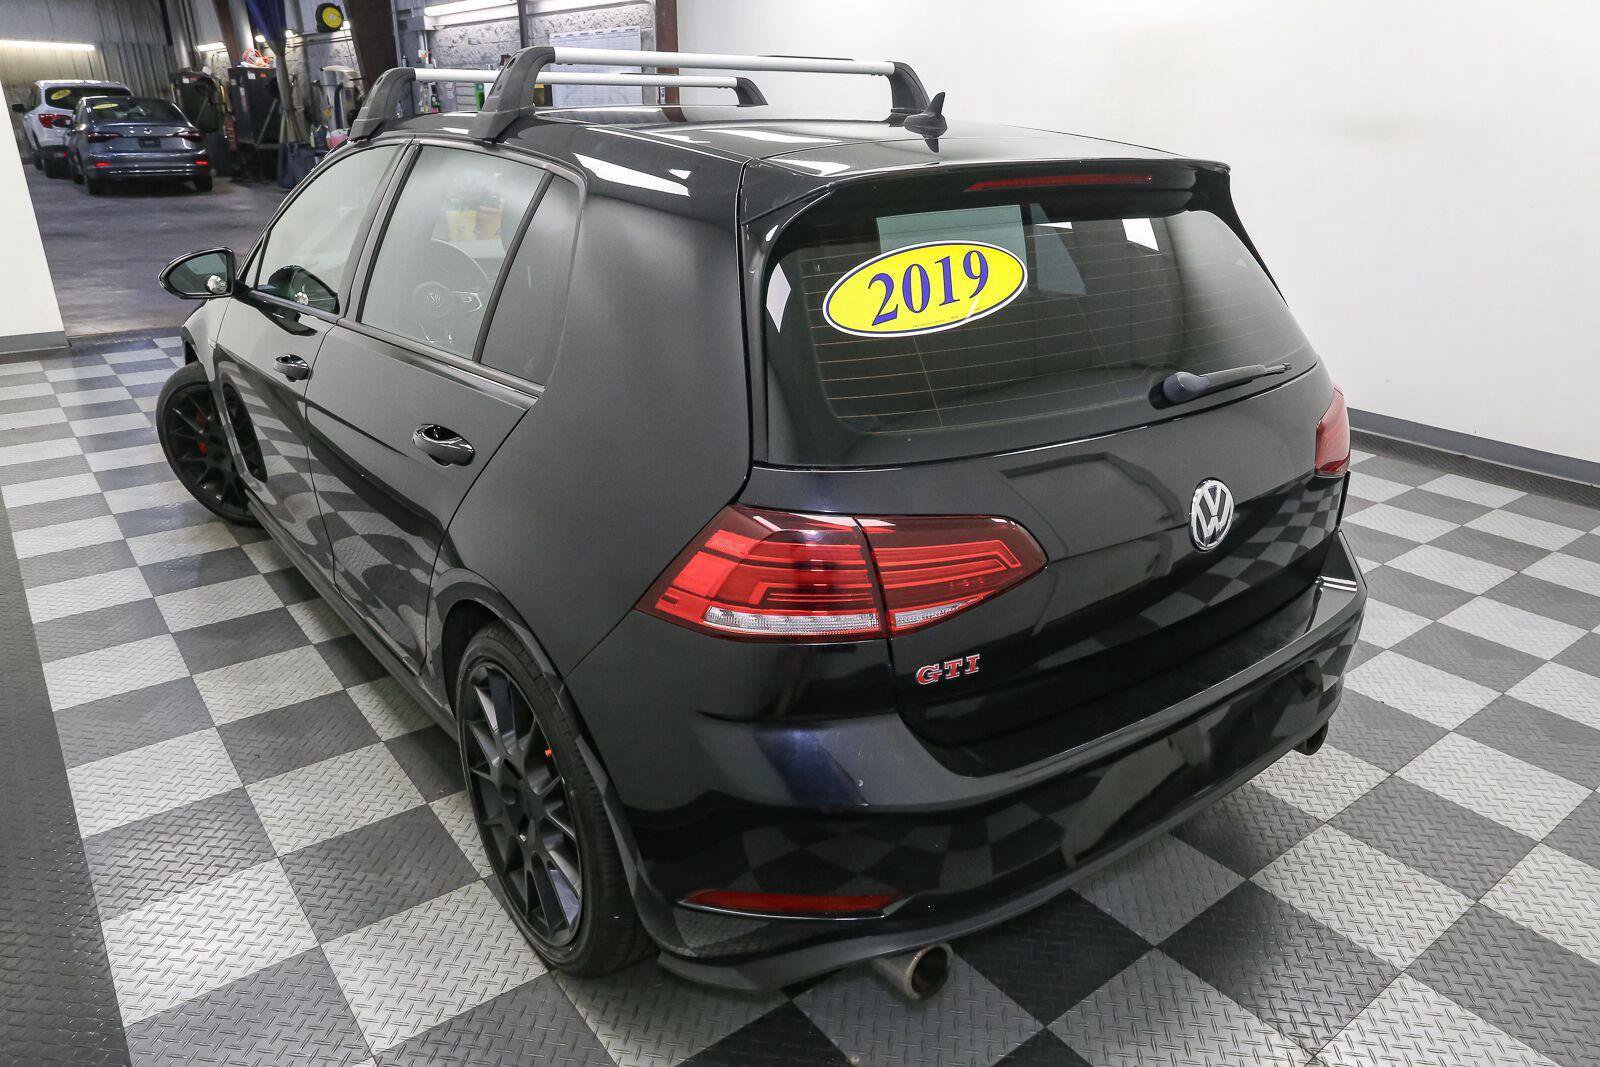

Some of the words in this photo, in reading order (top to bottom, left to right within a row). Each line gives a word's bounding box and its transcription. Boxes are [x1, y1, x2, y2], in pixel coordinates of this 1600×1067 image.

[867, 250, 989, 327] 2019
[1191, 479, 1234, 550] VW
[916, 653, 981, 685] GTI
